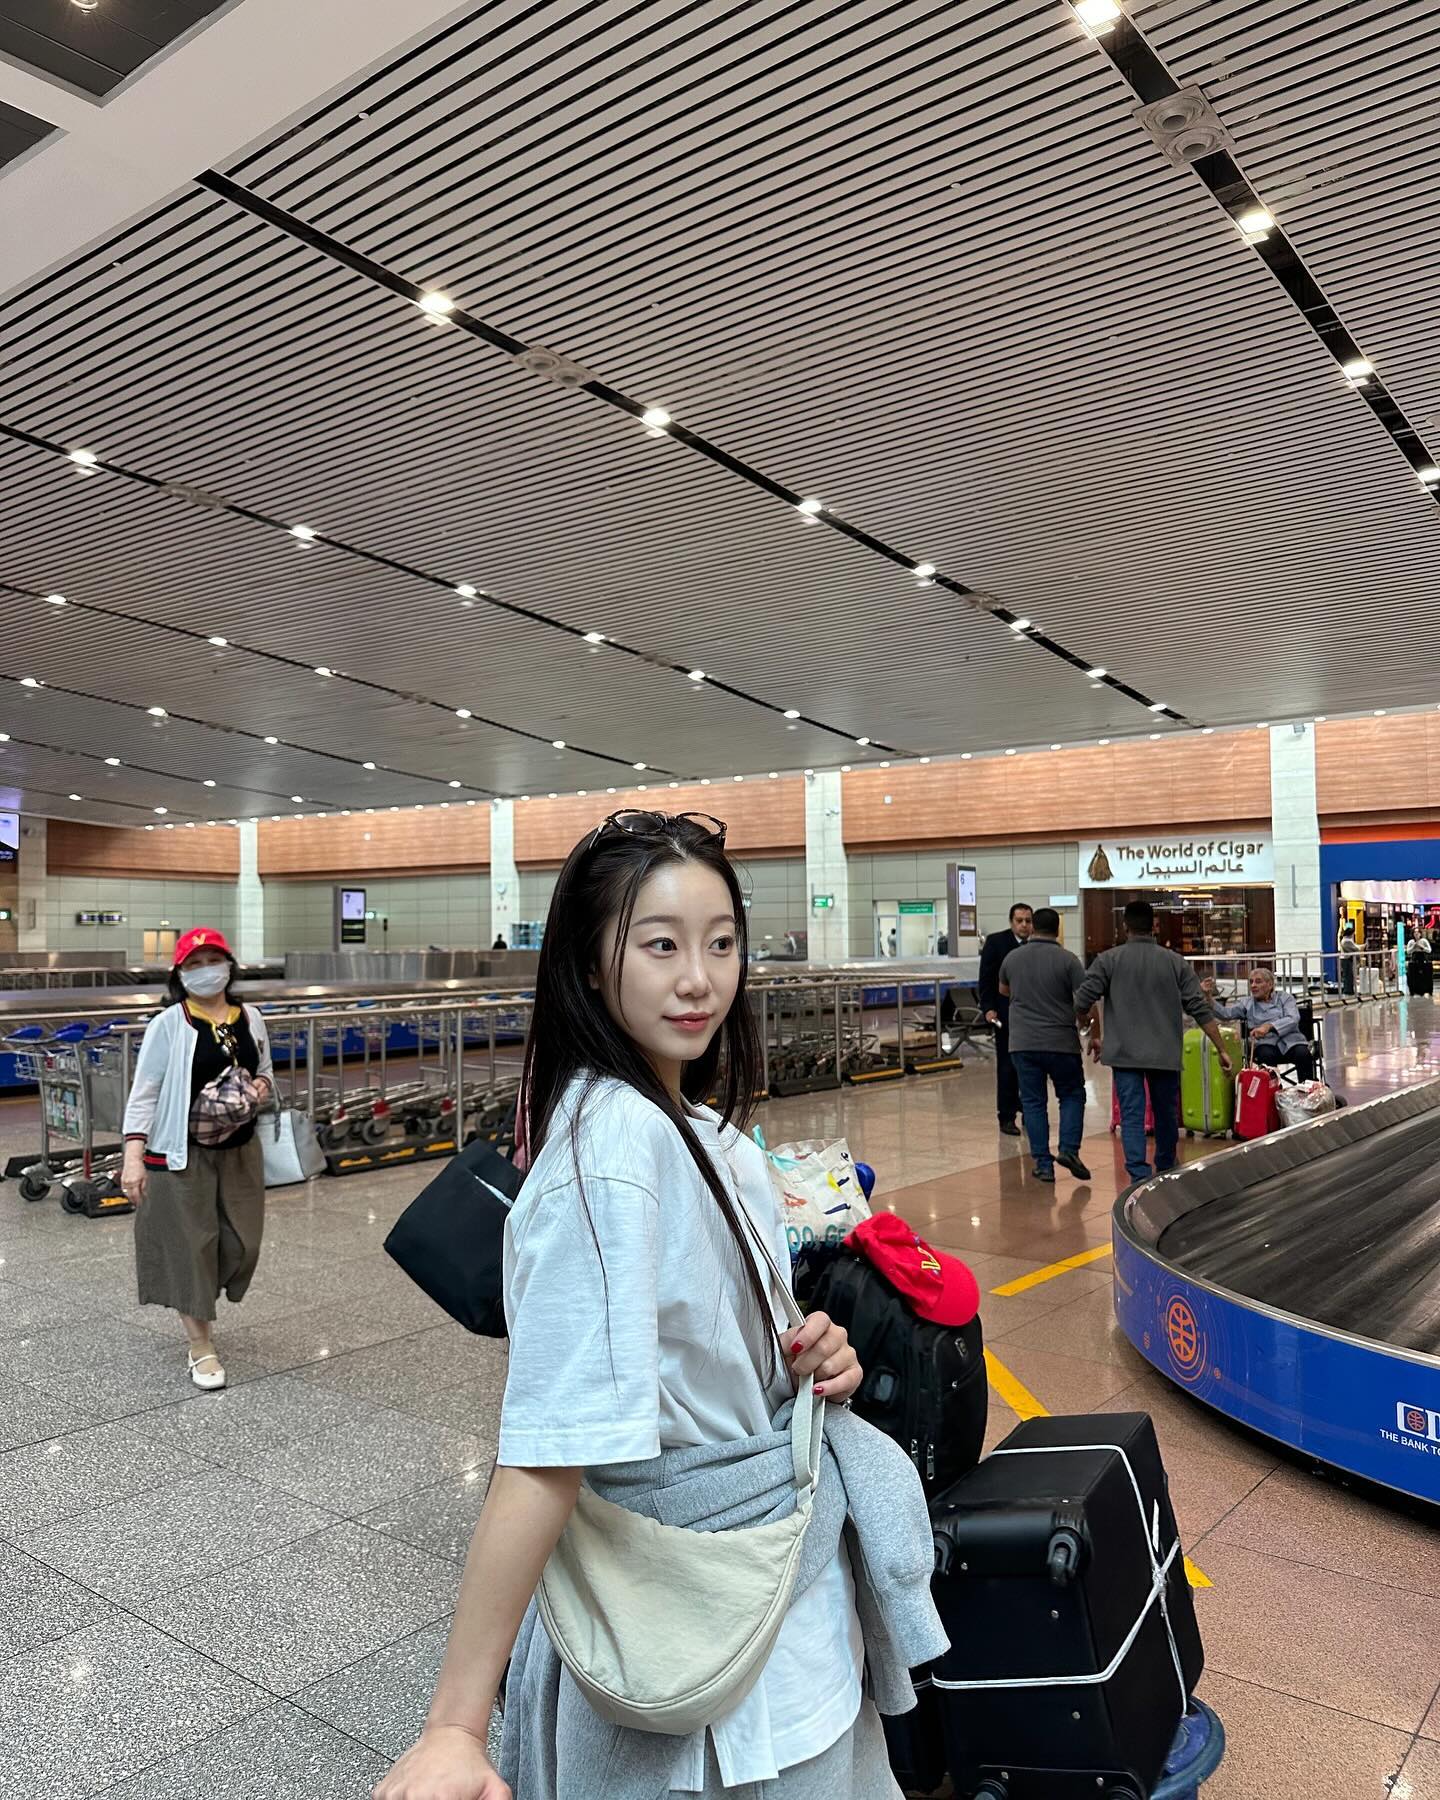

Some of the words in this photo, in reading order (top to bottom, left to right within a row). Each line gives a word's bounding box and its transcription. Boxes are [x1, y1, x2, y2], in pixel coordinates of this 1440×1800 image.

[1116, 847, 1144, 860] The
[1147, 843, 1193, 859] World
[1197, 842, 1214, 856] of
[1217, 841, 1263, 858] Cigar
[1138, 860, 1203, 880] السيجار
[1205, 859, 1244, 878] عالم
[1379, 1428, 1399, 1443] THE
[1401, 1436, 1429, 1453] BANK
